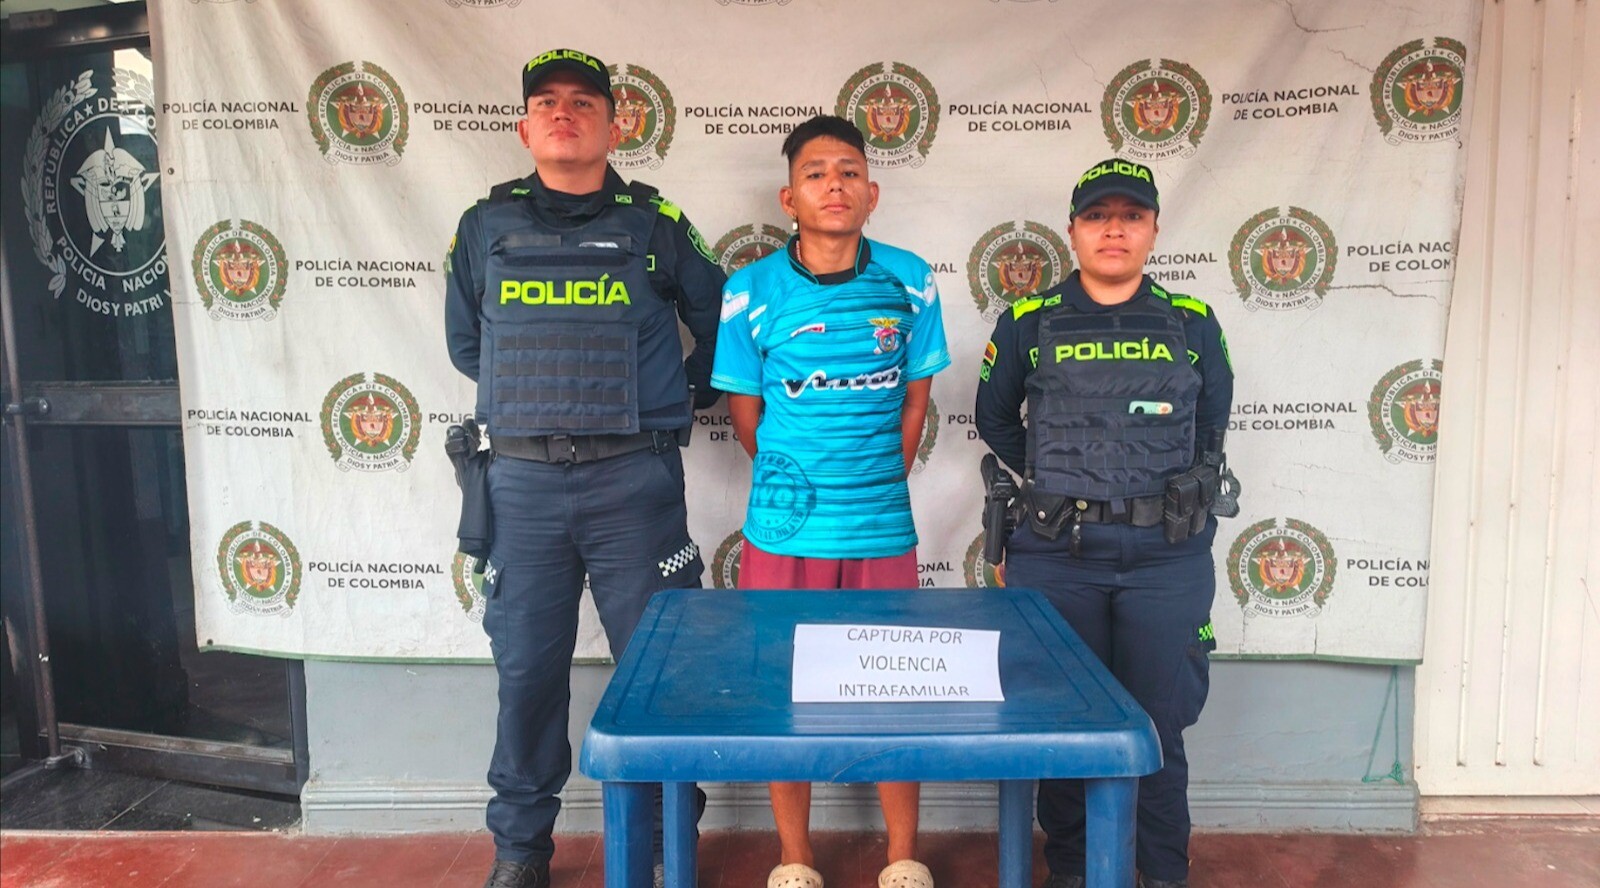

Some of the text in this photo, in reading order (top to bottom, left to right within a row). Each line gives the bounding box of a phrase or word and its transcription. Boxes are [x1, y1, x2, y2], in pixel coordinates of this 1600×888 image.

[373, 78, 398, 120] COLOMBIA
[1172, 74, 1197, 112] COLOMBIA
[1222, 84, 1360, 104] POLICÍA NACIONAL
[98, 98, 117, 111] DE
[162, 99, 298, 114] POLICÍA NACIONAL
[638, 81, 663, 123] COLOMBIA
[903, 79, 927, 122] COLOMBIA
[414, 100, 528, 116] POLICÍA NACIO
[685, 104, 826, 117] POLICÍA NACIONAL
[949, 101, 1092, 116] POLICÍA NACIONAL
[1234, 102, 1338, 120] DE COLOMBIA
[182, 118, 279, 130] DE COLOMBIA
[433, 120, 518, 132] DE COLOM
[704, 123, 797, 134] DE COLOMBI
[968, 120, 1071, 132] DE COLOMBIA
[361, 130, 397, 152] NACIONAL
[1156, 121, 1194, 148] NACIONAL
[888, 131, 923, 156] NACIONAL
[361, 152, 389, 162] PATRIA
[1156, 145, 1184, 158] PATRIA
[626, 156, 652, 166] PATRIA
[888, 155, 913, 166] PATRIA
[1299, 222, 1324, 263] COLOMBIA
[1347, 240, 1412, 256] POLICÍA
[57, 236, 106, 290] POLICIA
[252, 236, 276, 276] COLOMBIA
[1035, 236, 1059, 277] COLOMBIA
[1145, 252, 1217, 265] ACIONAL
[296, 258, 436, 272] POLICÍA NACIONAL
[1369, 260, 1390, 272] DE
[1149, 269, 1196, 281] OMBIA
[315, 277, 416, 288] DE COLOMBIA
[500, 273, 631, 305] POLICÍA
[1282, 273, 1320, 298] NACIONAL
[76, 288, 110, 314] DIOS
[111, 303, 120, 316] Y
[1282, 295, 1310, 308] PATRIA
[1055, 337, 1174, 363] POLICÍA
[384, 388, 409, 428] COLOMBIA
[1230, 401, 1357, 414] LICÍA NACIONAL
[188, 408, 312, 422] POLICÍA NACIONAL
[207, 426, 294, 437] DE COLOMBIA
[1228, 419, 1335, 431] DE COLOMBIA
[710, 432, 728, 442] DE
[373, 437, 406, 459] NACIONAL
[1297, 534, 1322, 573] COLOMBIA
[309, 560, 444, 574] POLICÍA NACIONAL
[1347, 556, 1412, 570] POLICÍA
[328, 577, 425, 589] DE COLOMBIA
[1369, 576, 1390, 587] DE
[1282, 583, 1320, 606] NACIONAL
[1282, 604, 1310, 615] PATRIA
[847, 628, 963, 644] CAPTURA POR
[859, 655, 947, 672] VIOLENCIA
[839, 684, 970, 696] INTRAFAMILIAR
